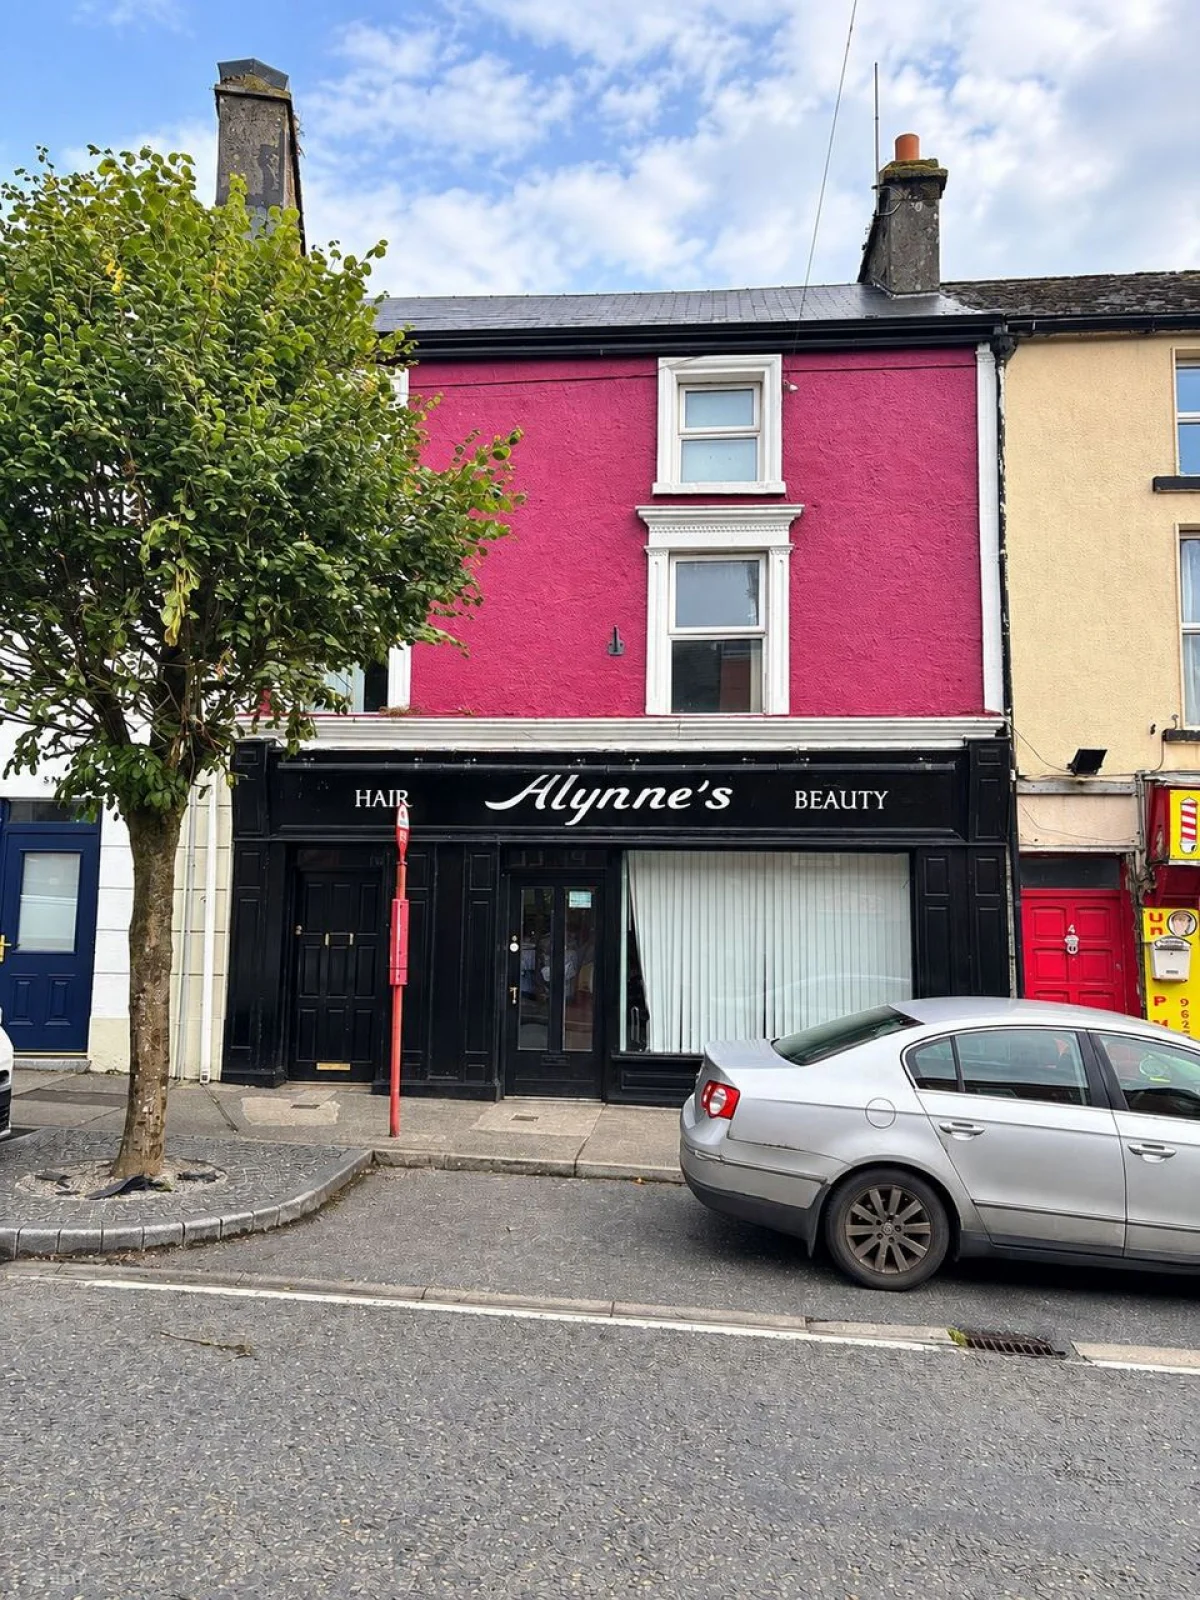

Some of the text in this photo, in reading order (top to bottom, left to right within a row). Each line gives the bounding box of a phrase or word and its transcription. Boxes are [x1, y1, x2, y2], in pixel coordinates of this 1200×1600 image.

[355, 774, 889, 826] HAIR Alynne's BEAUTY
